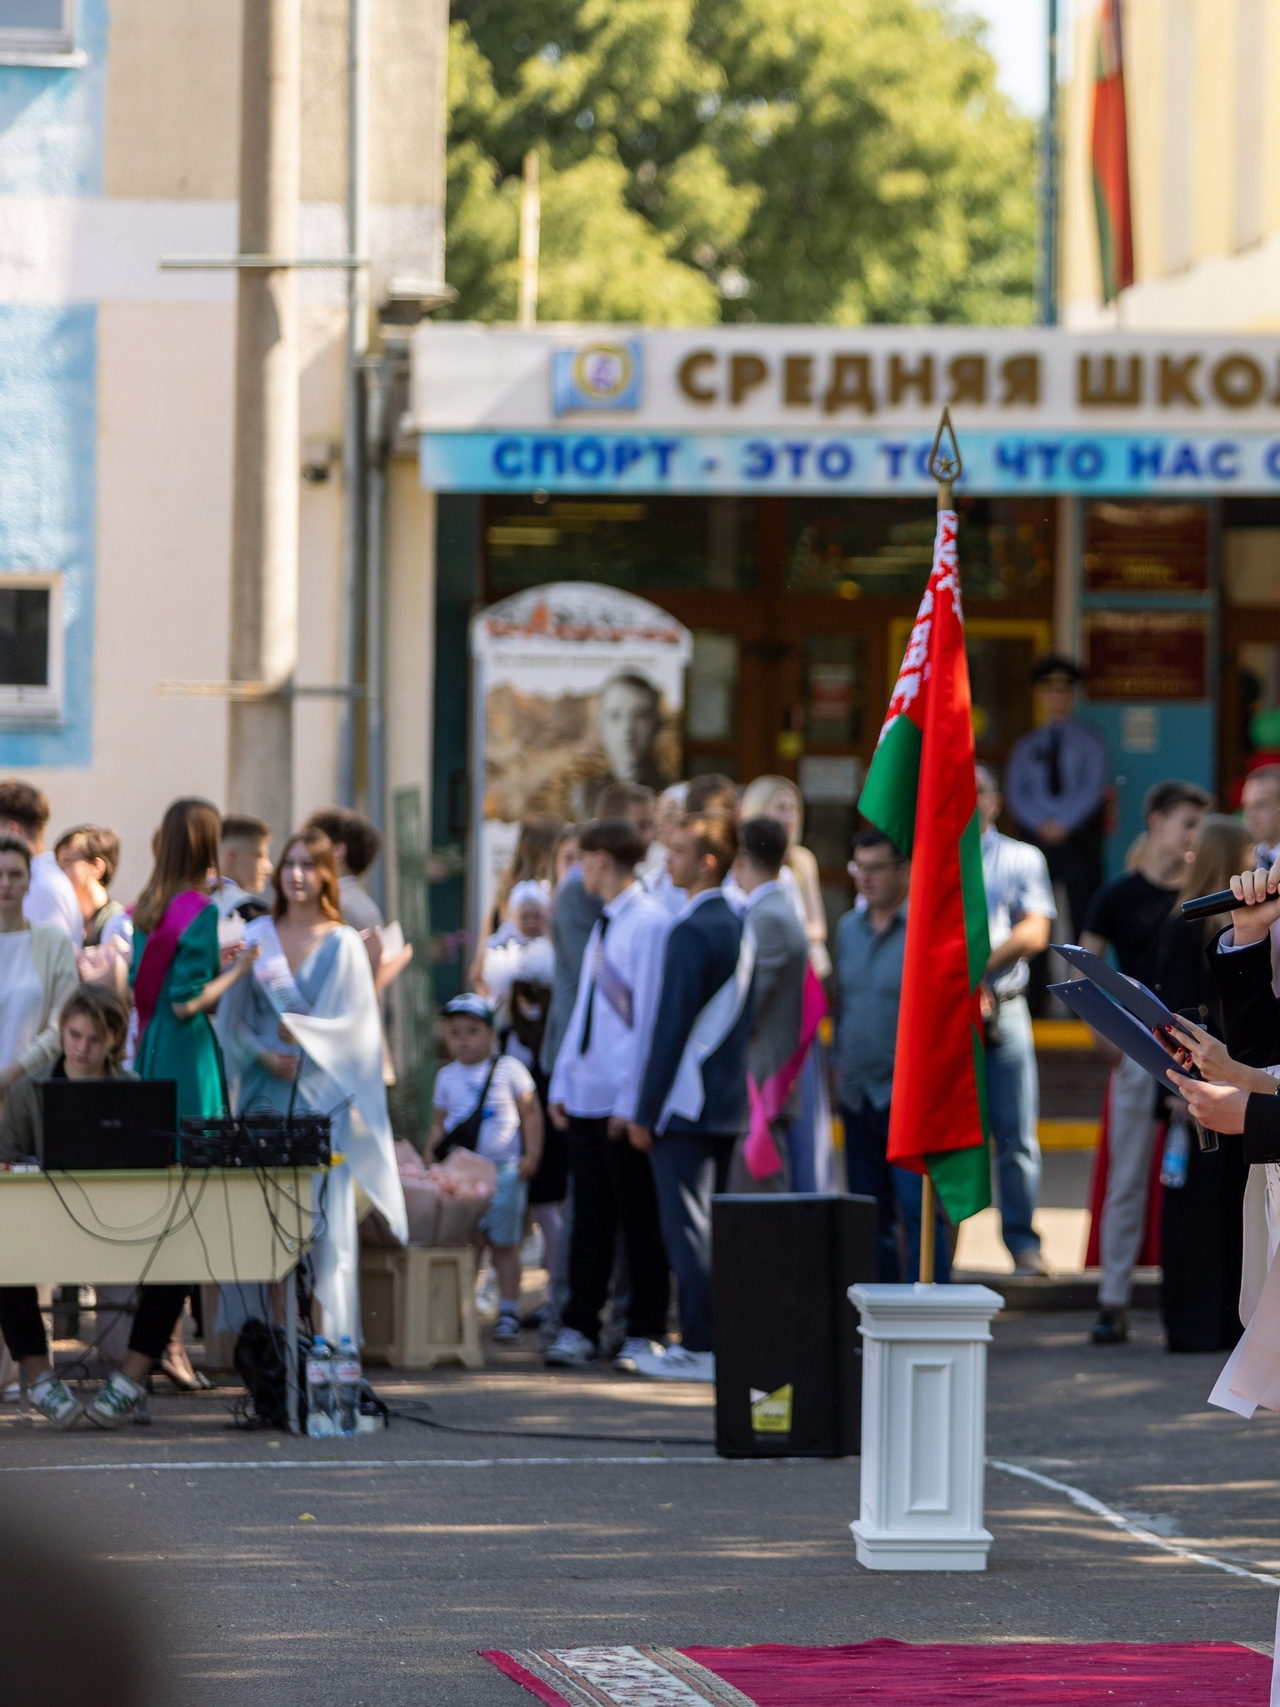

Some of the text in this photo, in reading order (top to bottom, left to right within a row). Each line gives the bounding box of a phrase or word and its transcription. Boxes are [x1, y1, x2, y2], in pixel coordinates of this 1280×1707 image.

[676, 349, 1042, 418] СРЕДНЯЯ
[491, 438, 681, 479] СПОРТ
[742, 441, 855, 480] ЭТО
[995, 440, 1106, 481] ЧТО
[1129, 442, 1239, 481] НАС
